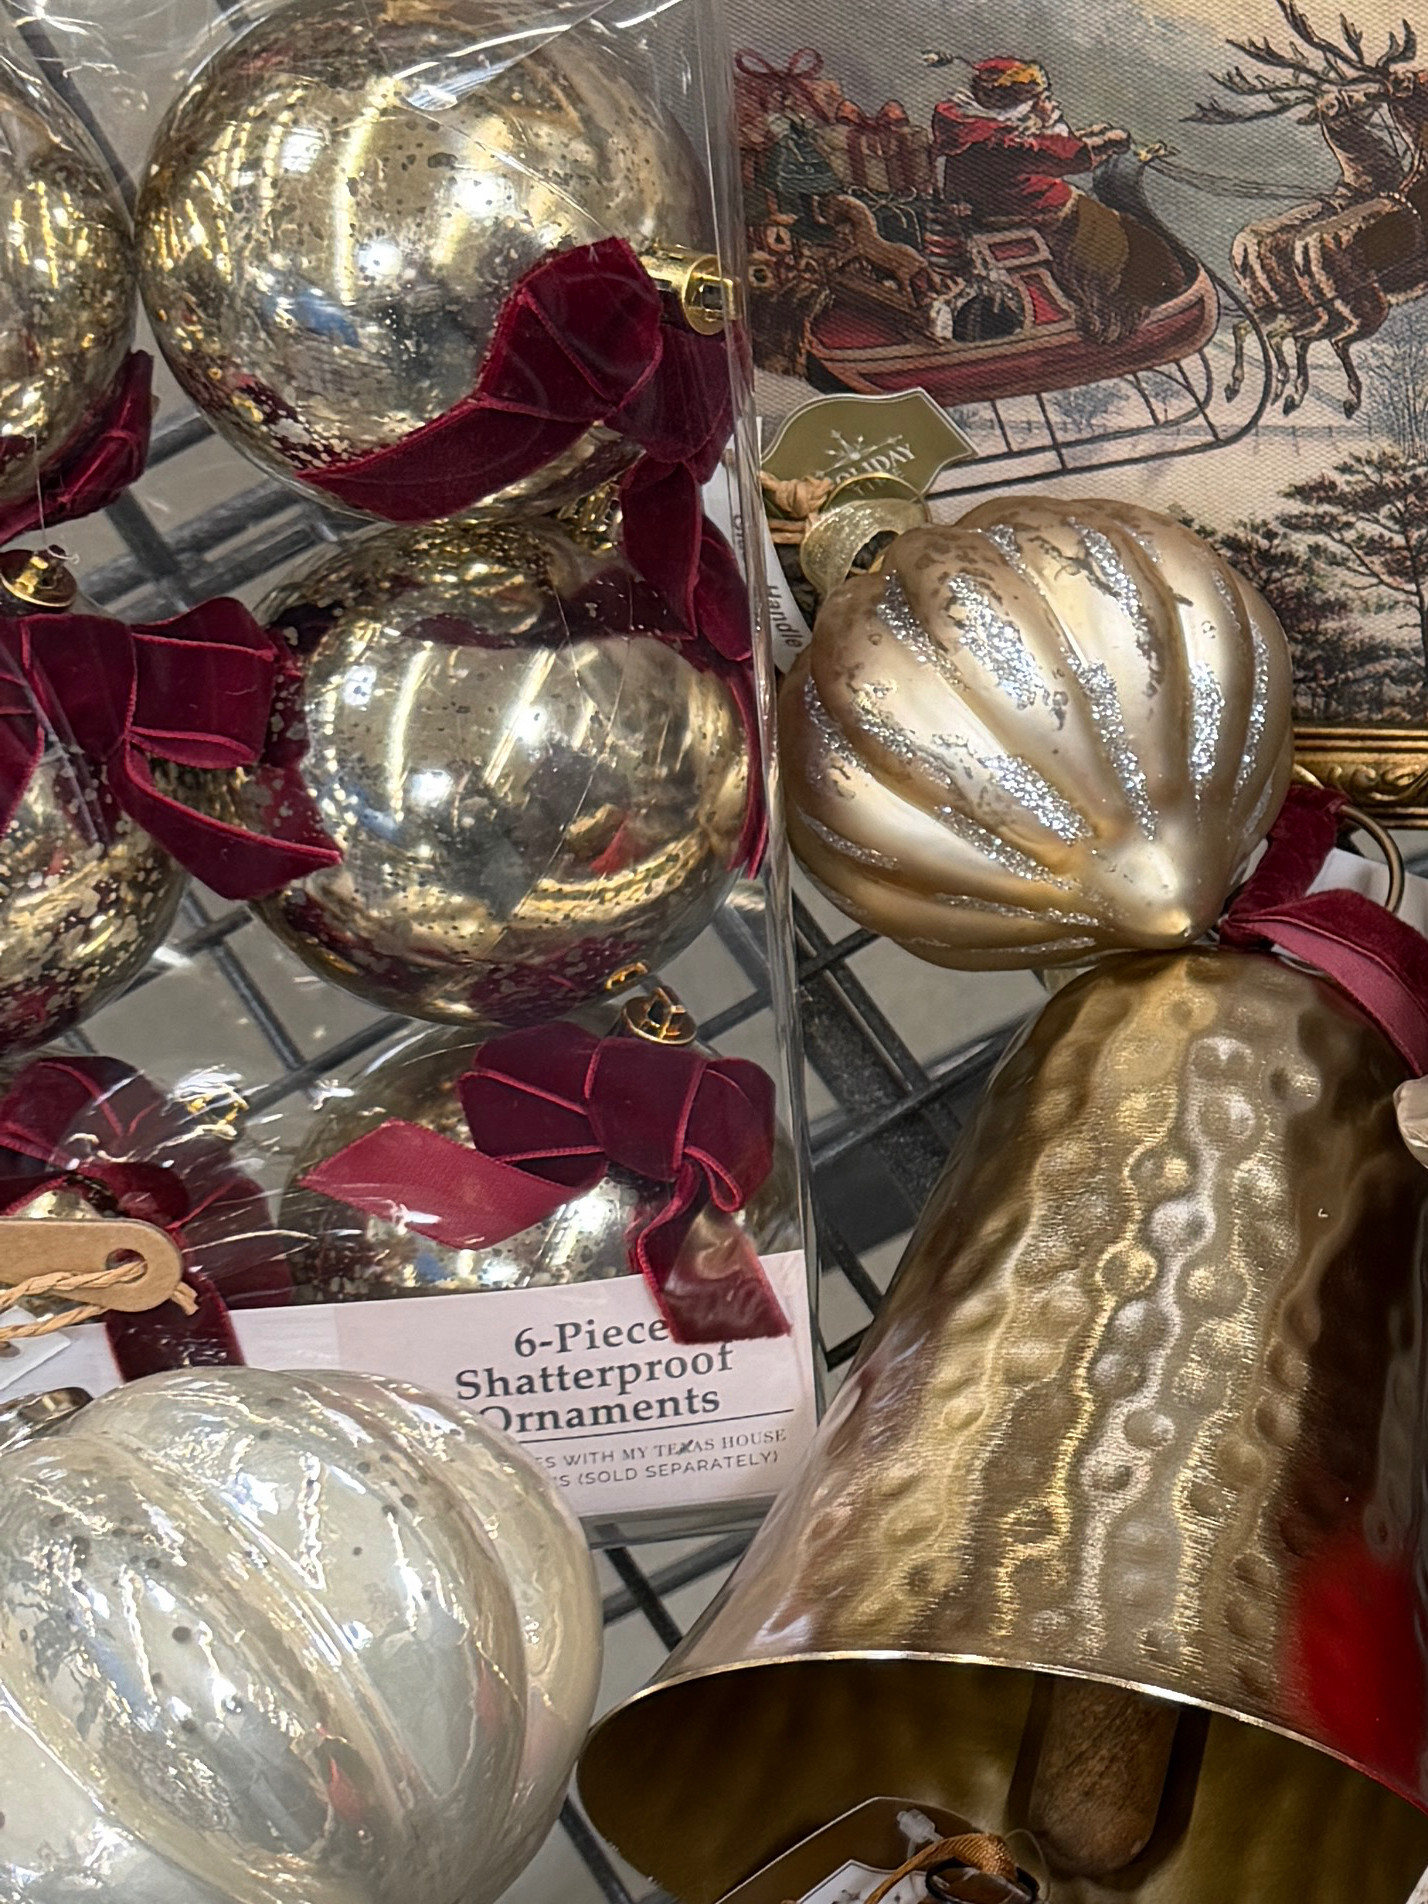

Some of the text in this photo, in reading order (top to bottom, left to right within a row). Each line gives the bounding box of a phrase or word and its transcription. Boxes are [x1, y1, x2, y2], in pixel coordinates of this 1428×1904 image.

[515, 1319, 669, 1358] 6-Piece
[455, 1341, 733, 1400] Shatterproof
[562, 1451, 615, 1467] WITH
[621, 1446, 647, 1461] MY
[653, 1439, 715, 1458] TEXAS
[721, 1429, 787, 1449] HOUSE
[578, 1468, 638, 1486] (SOLD
[645, 1451, 779, 1479] SEPARATELY)
